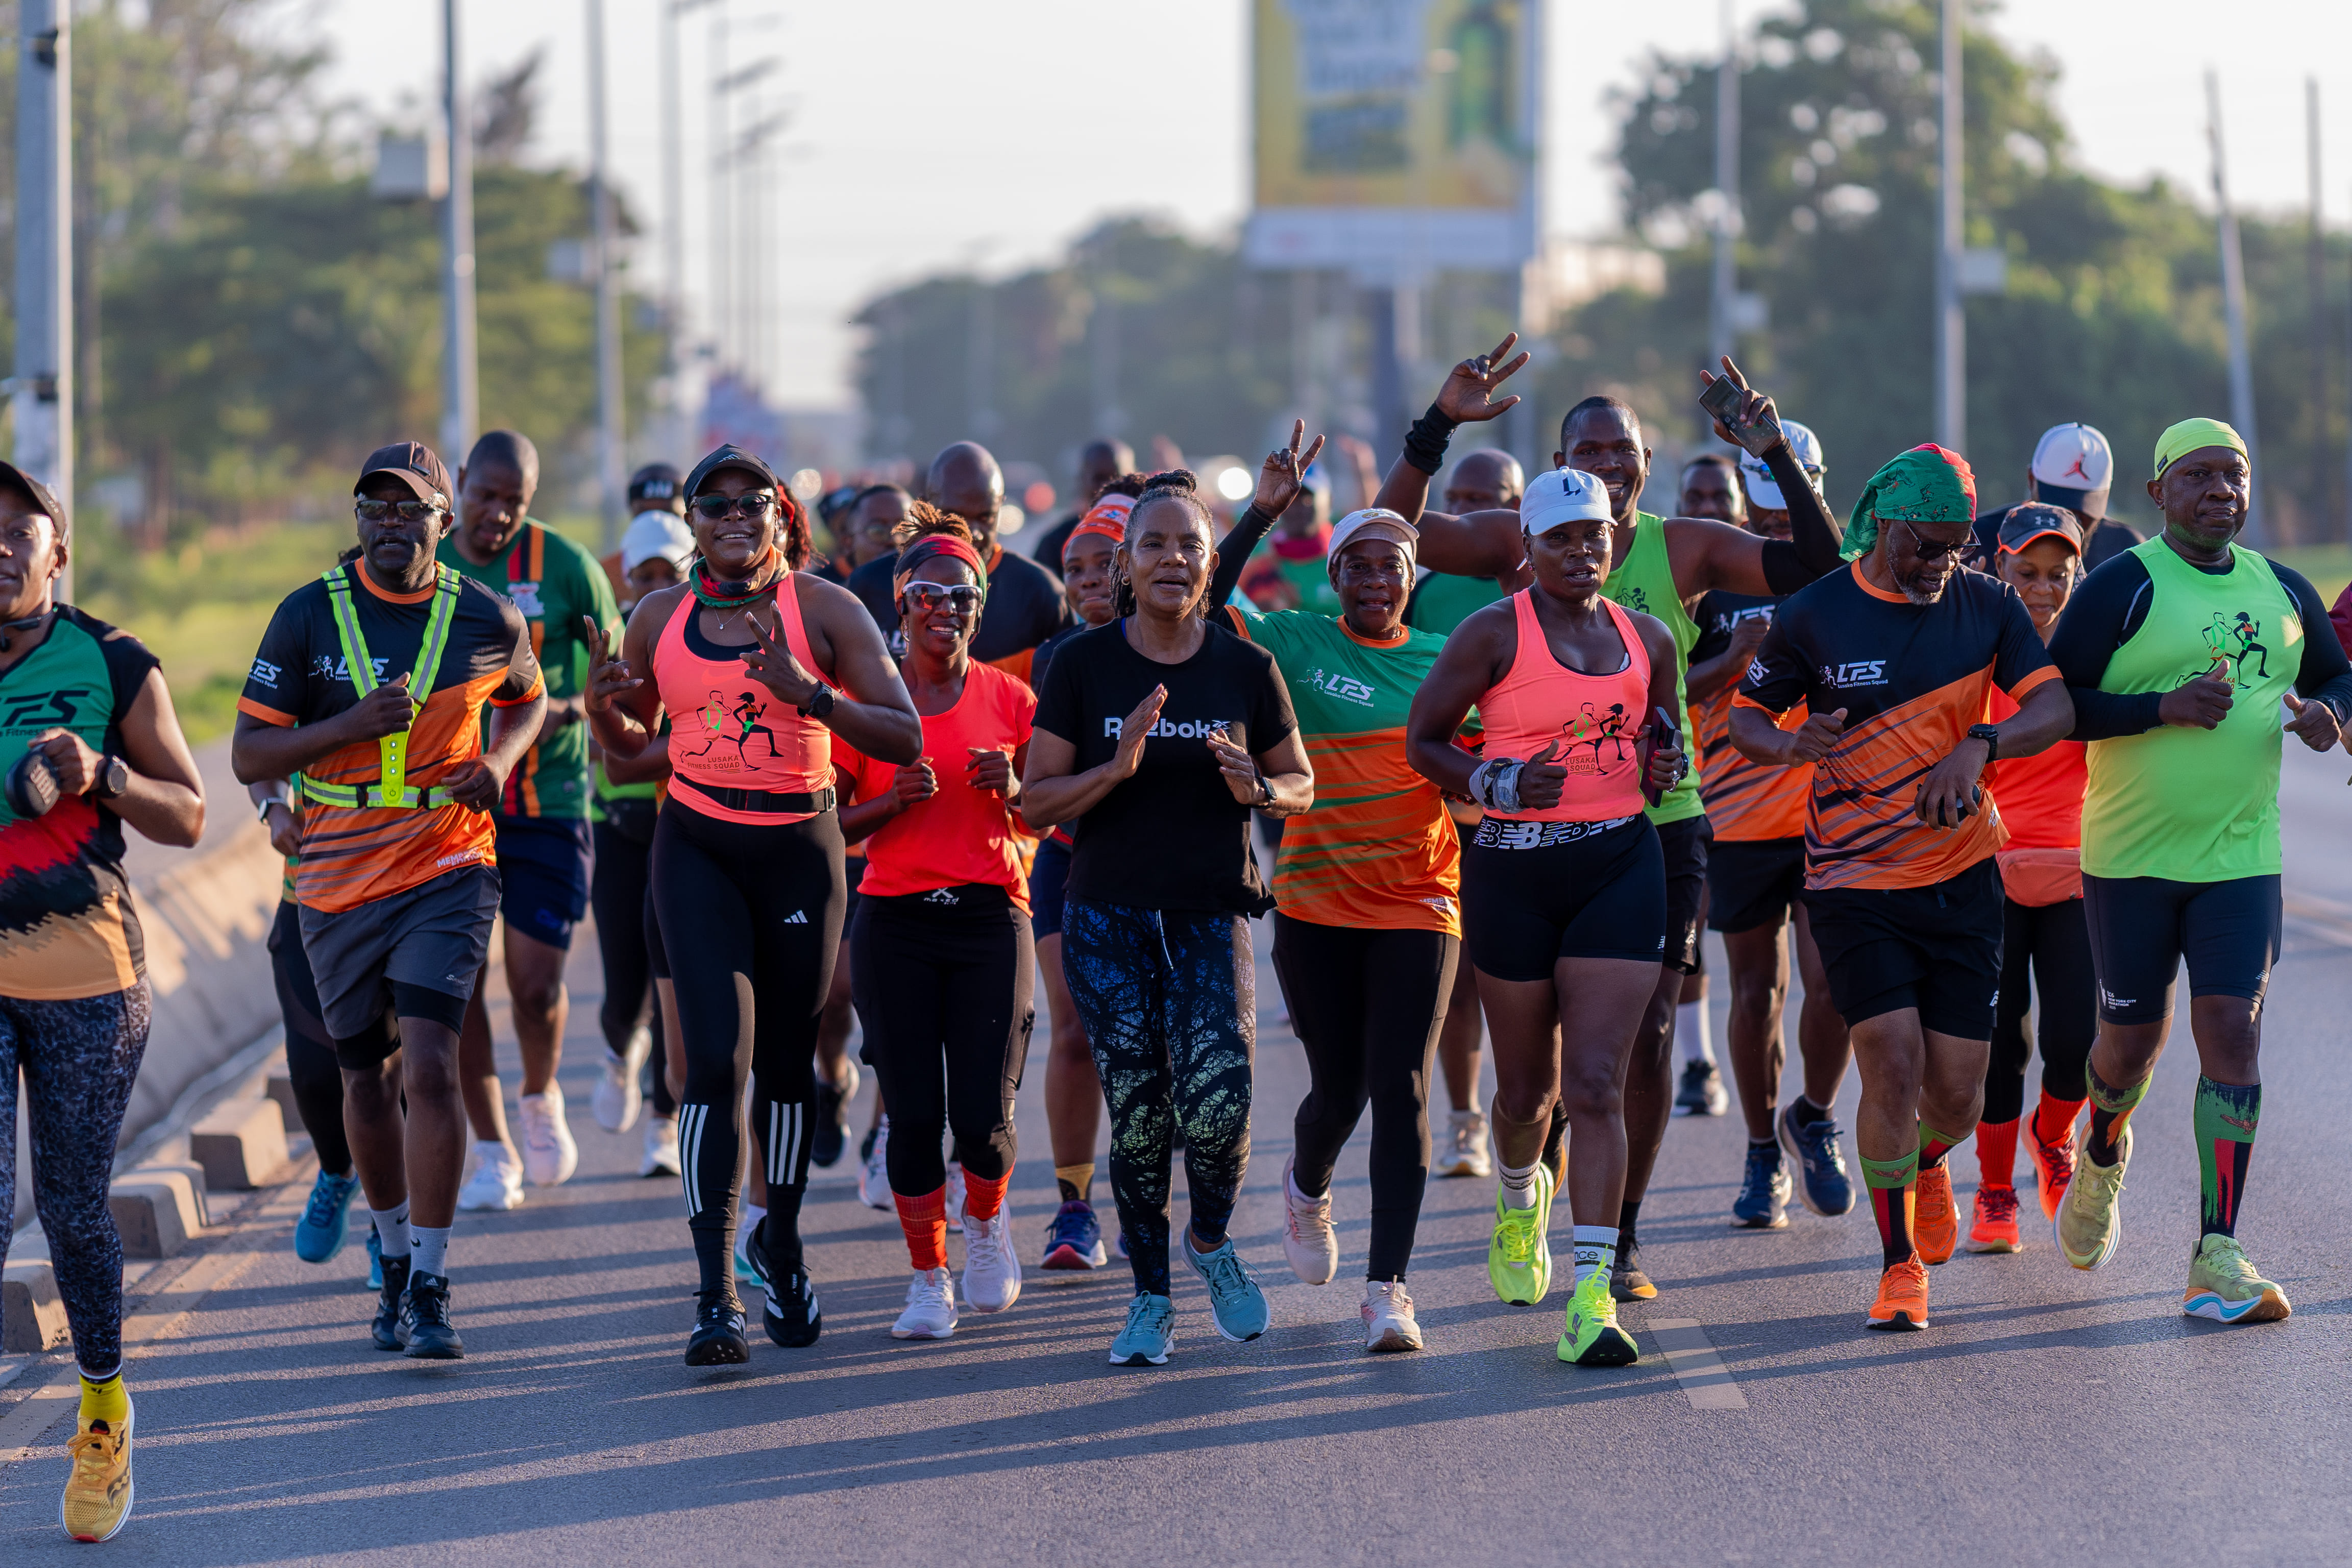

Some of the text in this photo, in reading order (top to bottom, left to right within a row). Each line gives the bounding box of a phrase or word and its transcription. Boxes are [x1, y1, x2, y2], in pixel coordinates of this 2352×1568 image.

[250, 657, 282, 682] FS
[335, 656, 389, 676] LS
[1837, 660, 1886, 682] LFS
[1325, 673, 1375, 701] LFS
[1324, 689, 1374, 708] Lusaka Fitness Squad
[0, 690, 90, 727] FS
[707, 755, 739, 763] LUSAKA
[715, 762, 740, 770] SQUAD
[1565, 757, 1596, 765] LUSAKA
[1570, 764, 1596, 772] SQUAD
